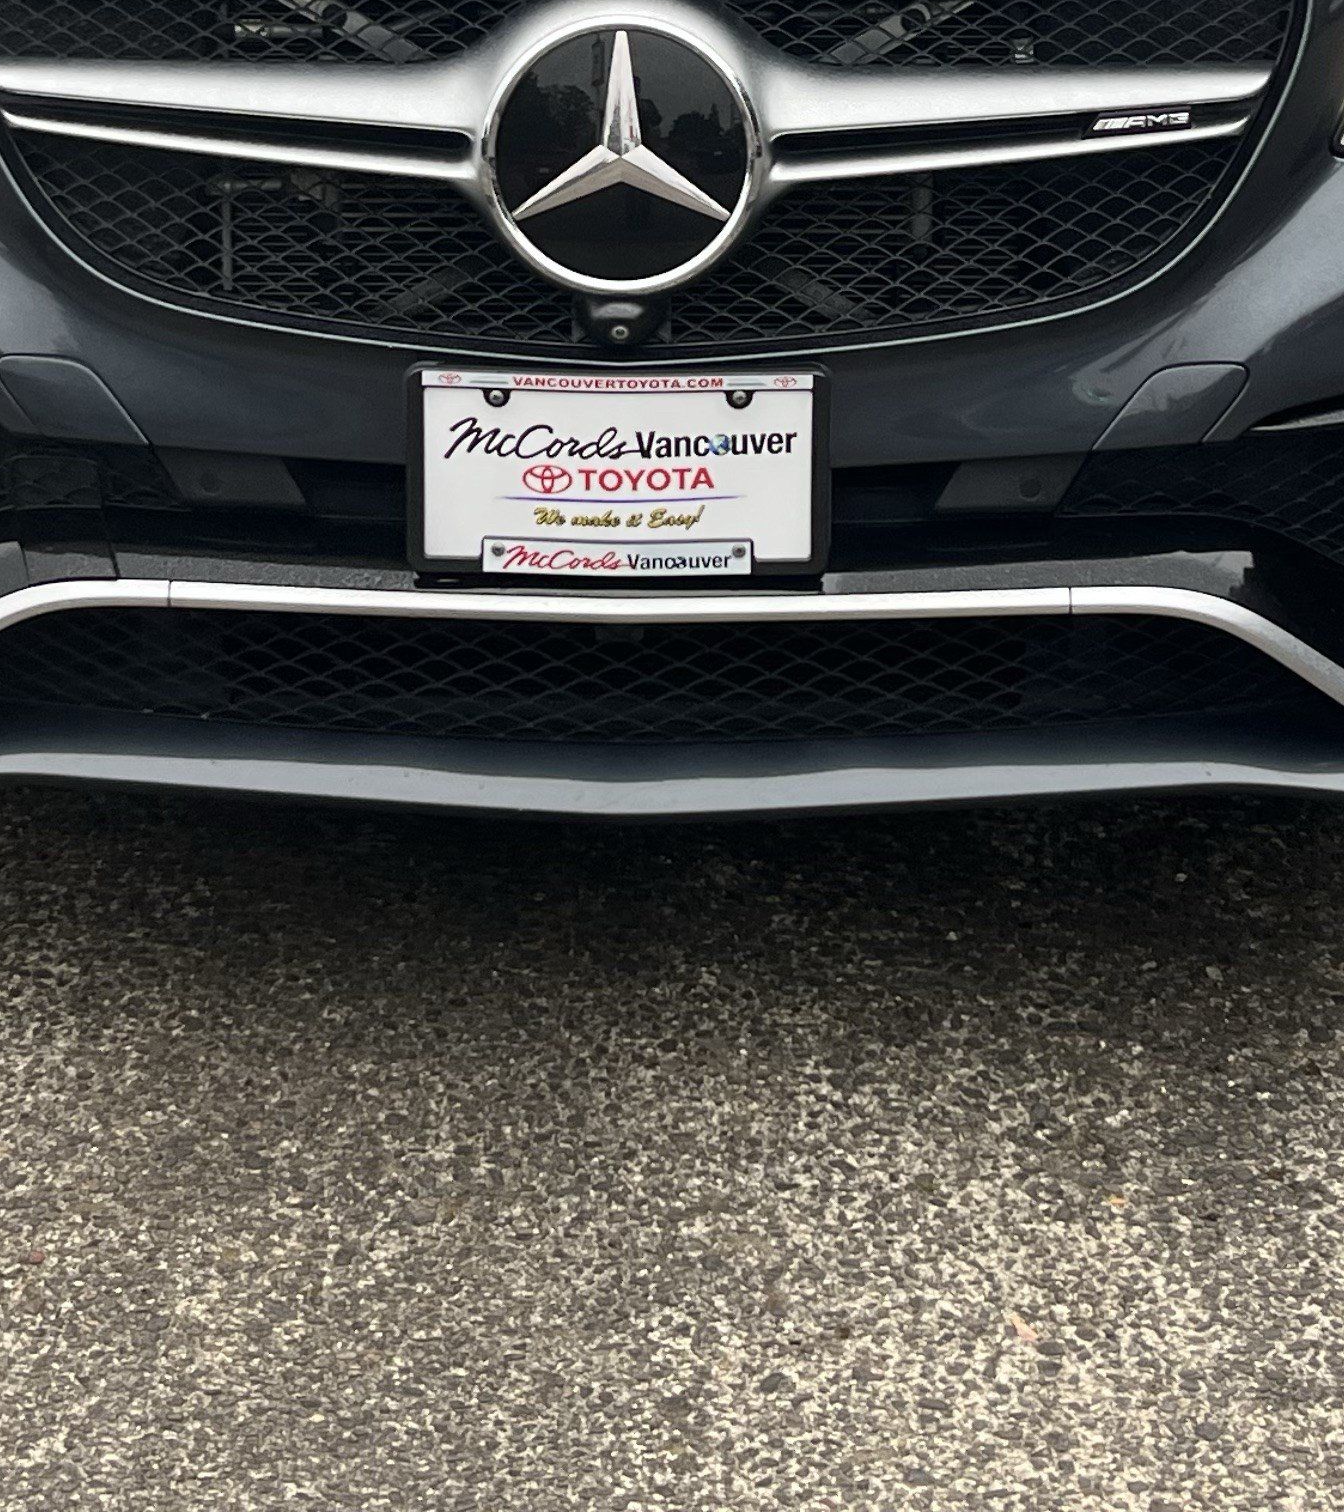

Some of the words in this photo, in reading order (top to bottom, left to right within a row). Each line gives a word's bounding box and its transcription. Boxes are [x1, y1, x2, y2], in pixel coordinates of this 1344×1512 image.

[1120, 112, 1190, 128] AMG
[512, 375, 724, 389] VANCOUVERTOYOTA.COM
[444, 417, 636, 459] McCords
[635, 430, 797, 459] Vancouver
[577, 467, 715, 492] TOYOTA
[534, 507, 566, 526] We
[647, 504, 706, 530] Easy!
[503, 545, 624, 570] McCords
[626, 553, 732, 570] Vancouver
